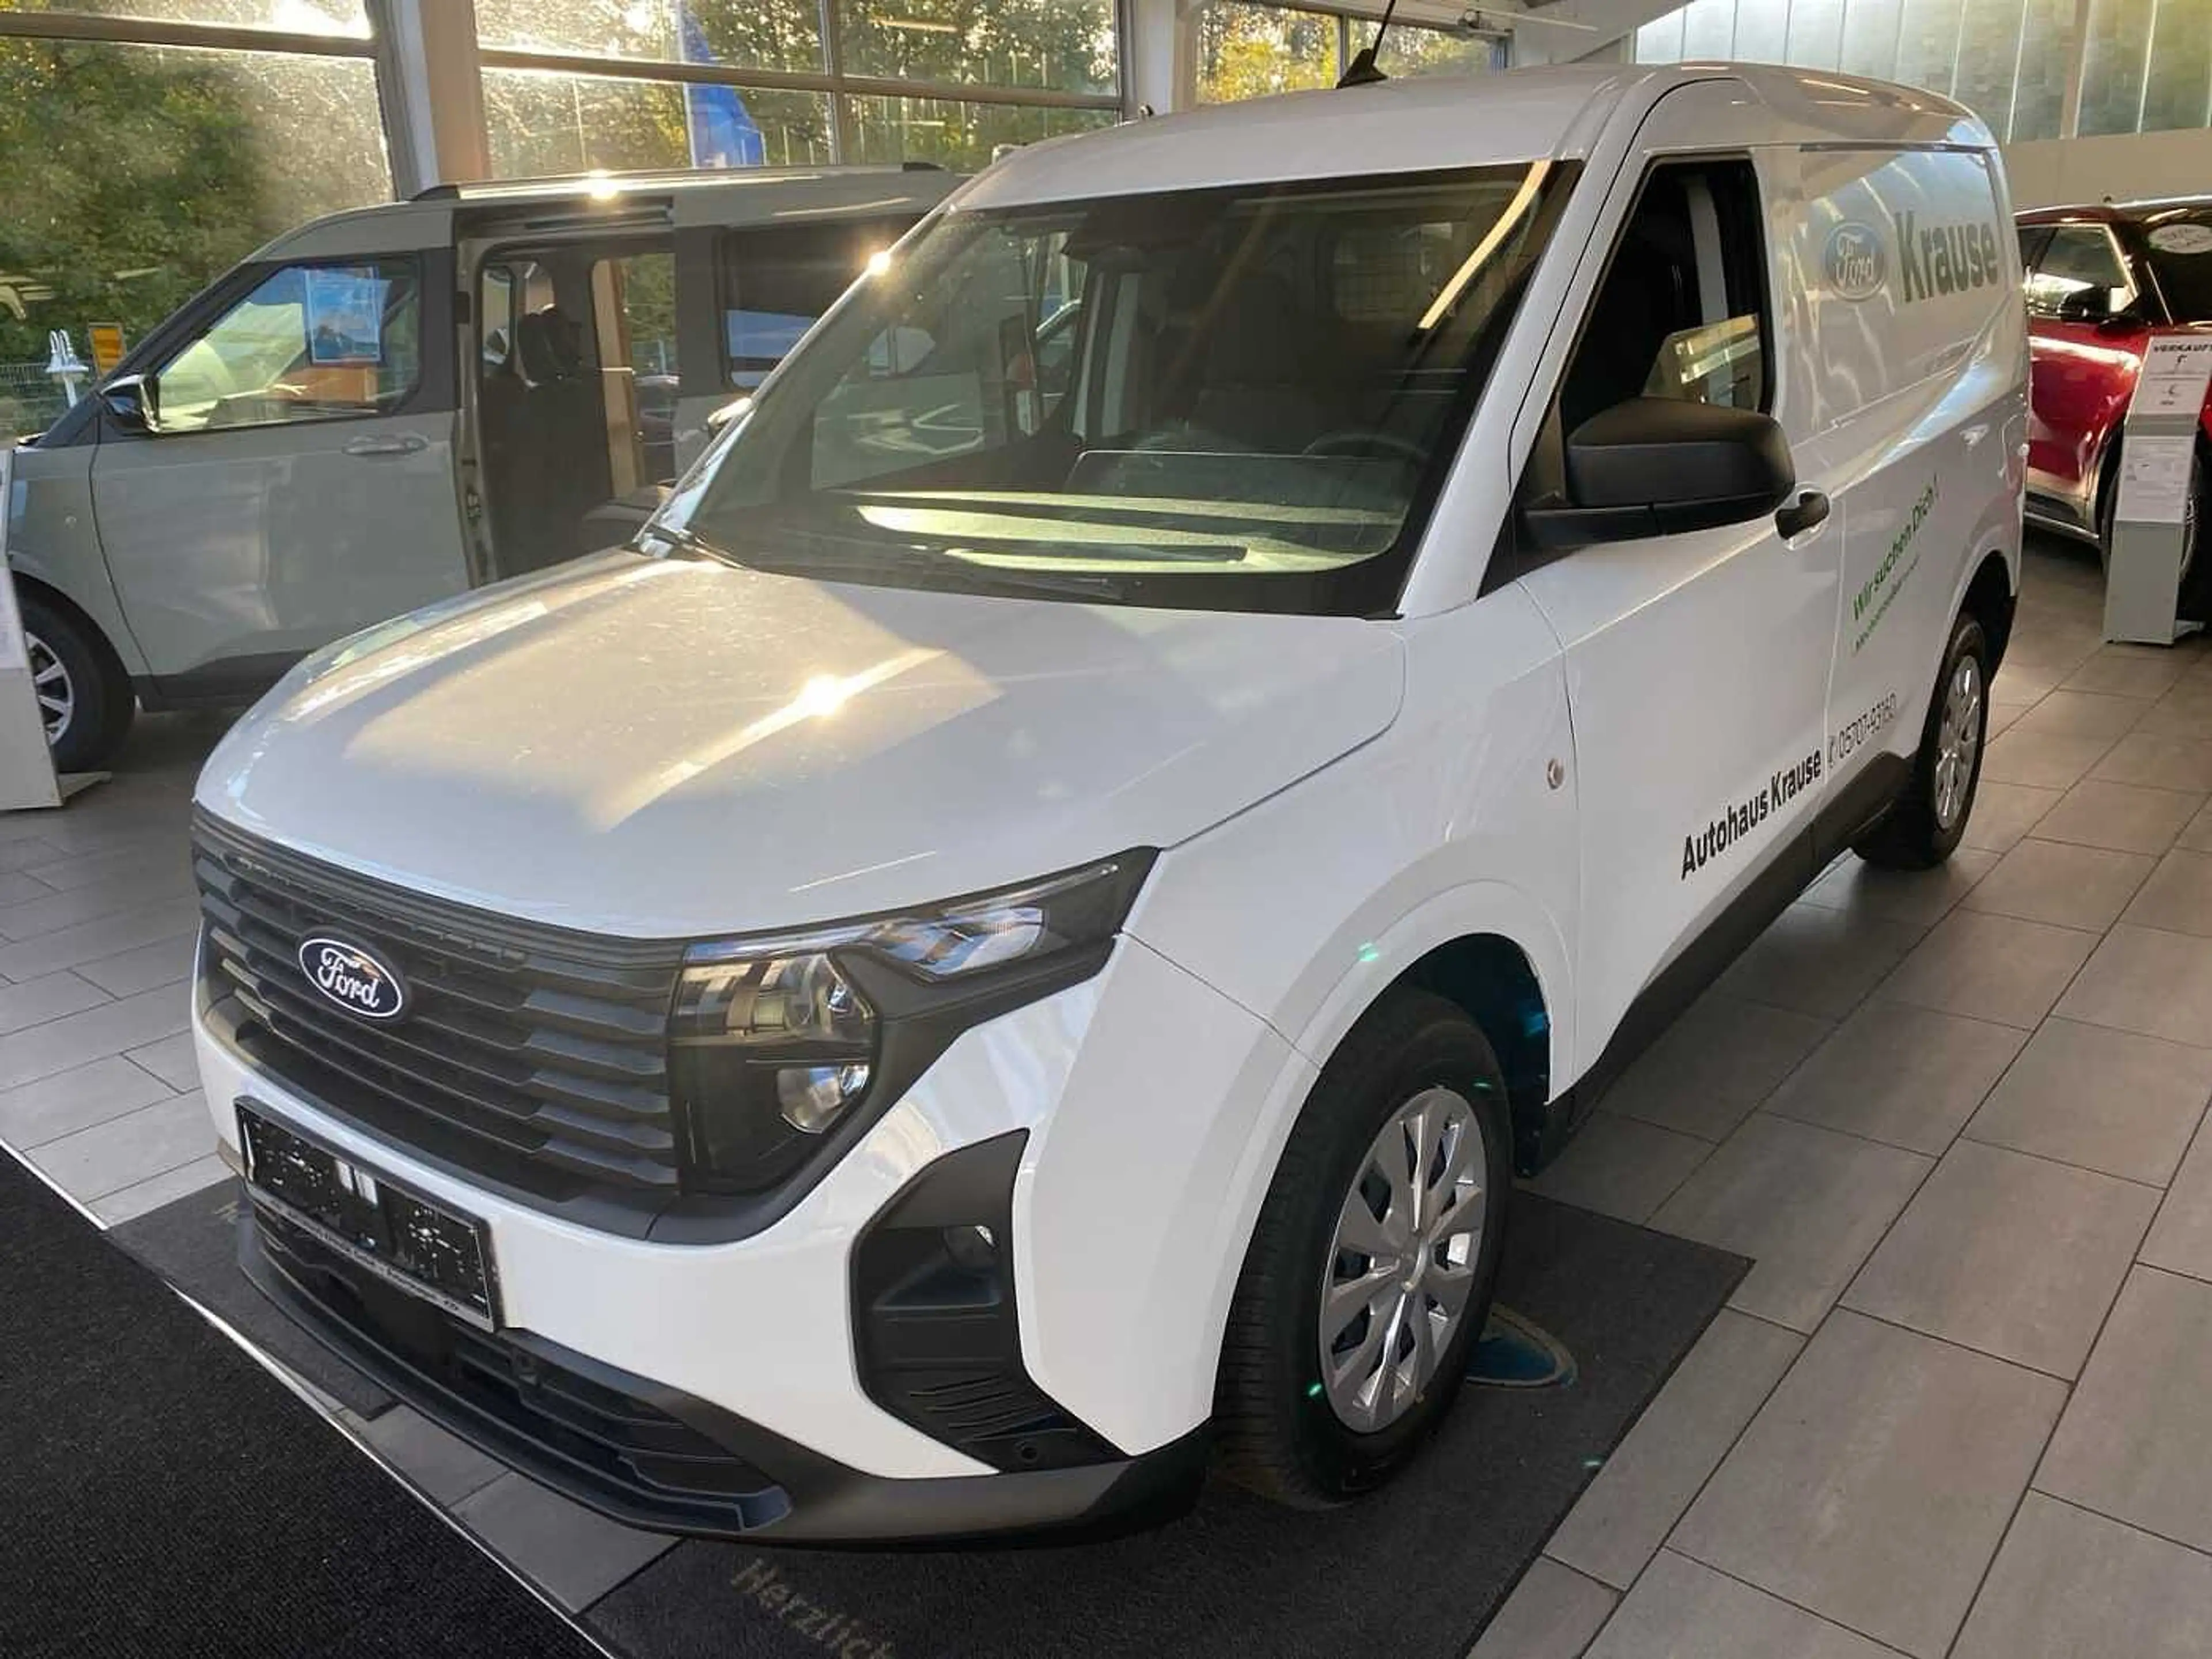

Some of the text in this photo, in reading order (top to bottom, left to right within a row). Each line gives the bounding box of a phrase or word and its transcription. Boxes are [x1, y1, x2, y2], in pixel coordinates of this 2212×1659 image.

[1832, 231, 1873, 289] Ford
[1895, 210, 1998, 302] Krause
[2153, 344, 2212, 352] VERKAUF
[1853, 581, 1873, 620] Wir
[1873, 525, 1911, 592] suchen
[1681, 790, 1769, 880] Autohaus
[1770, 749, 1821, 812] Krause
[318, 948, 380, 1008] Ford
